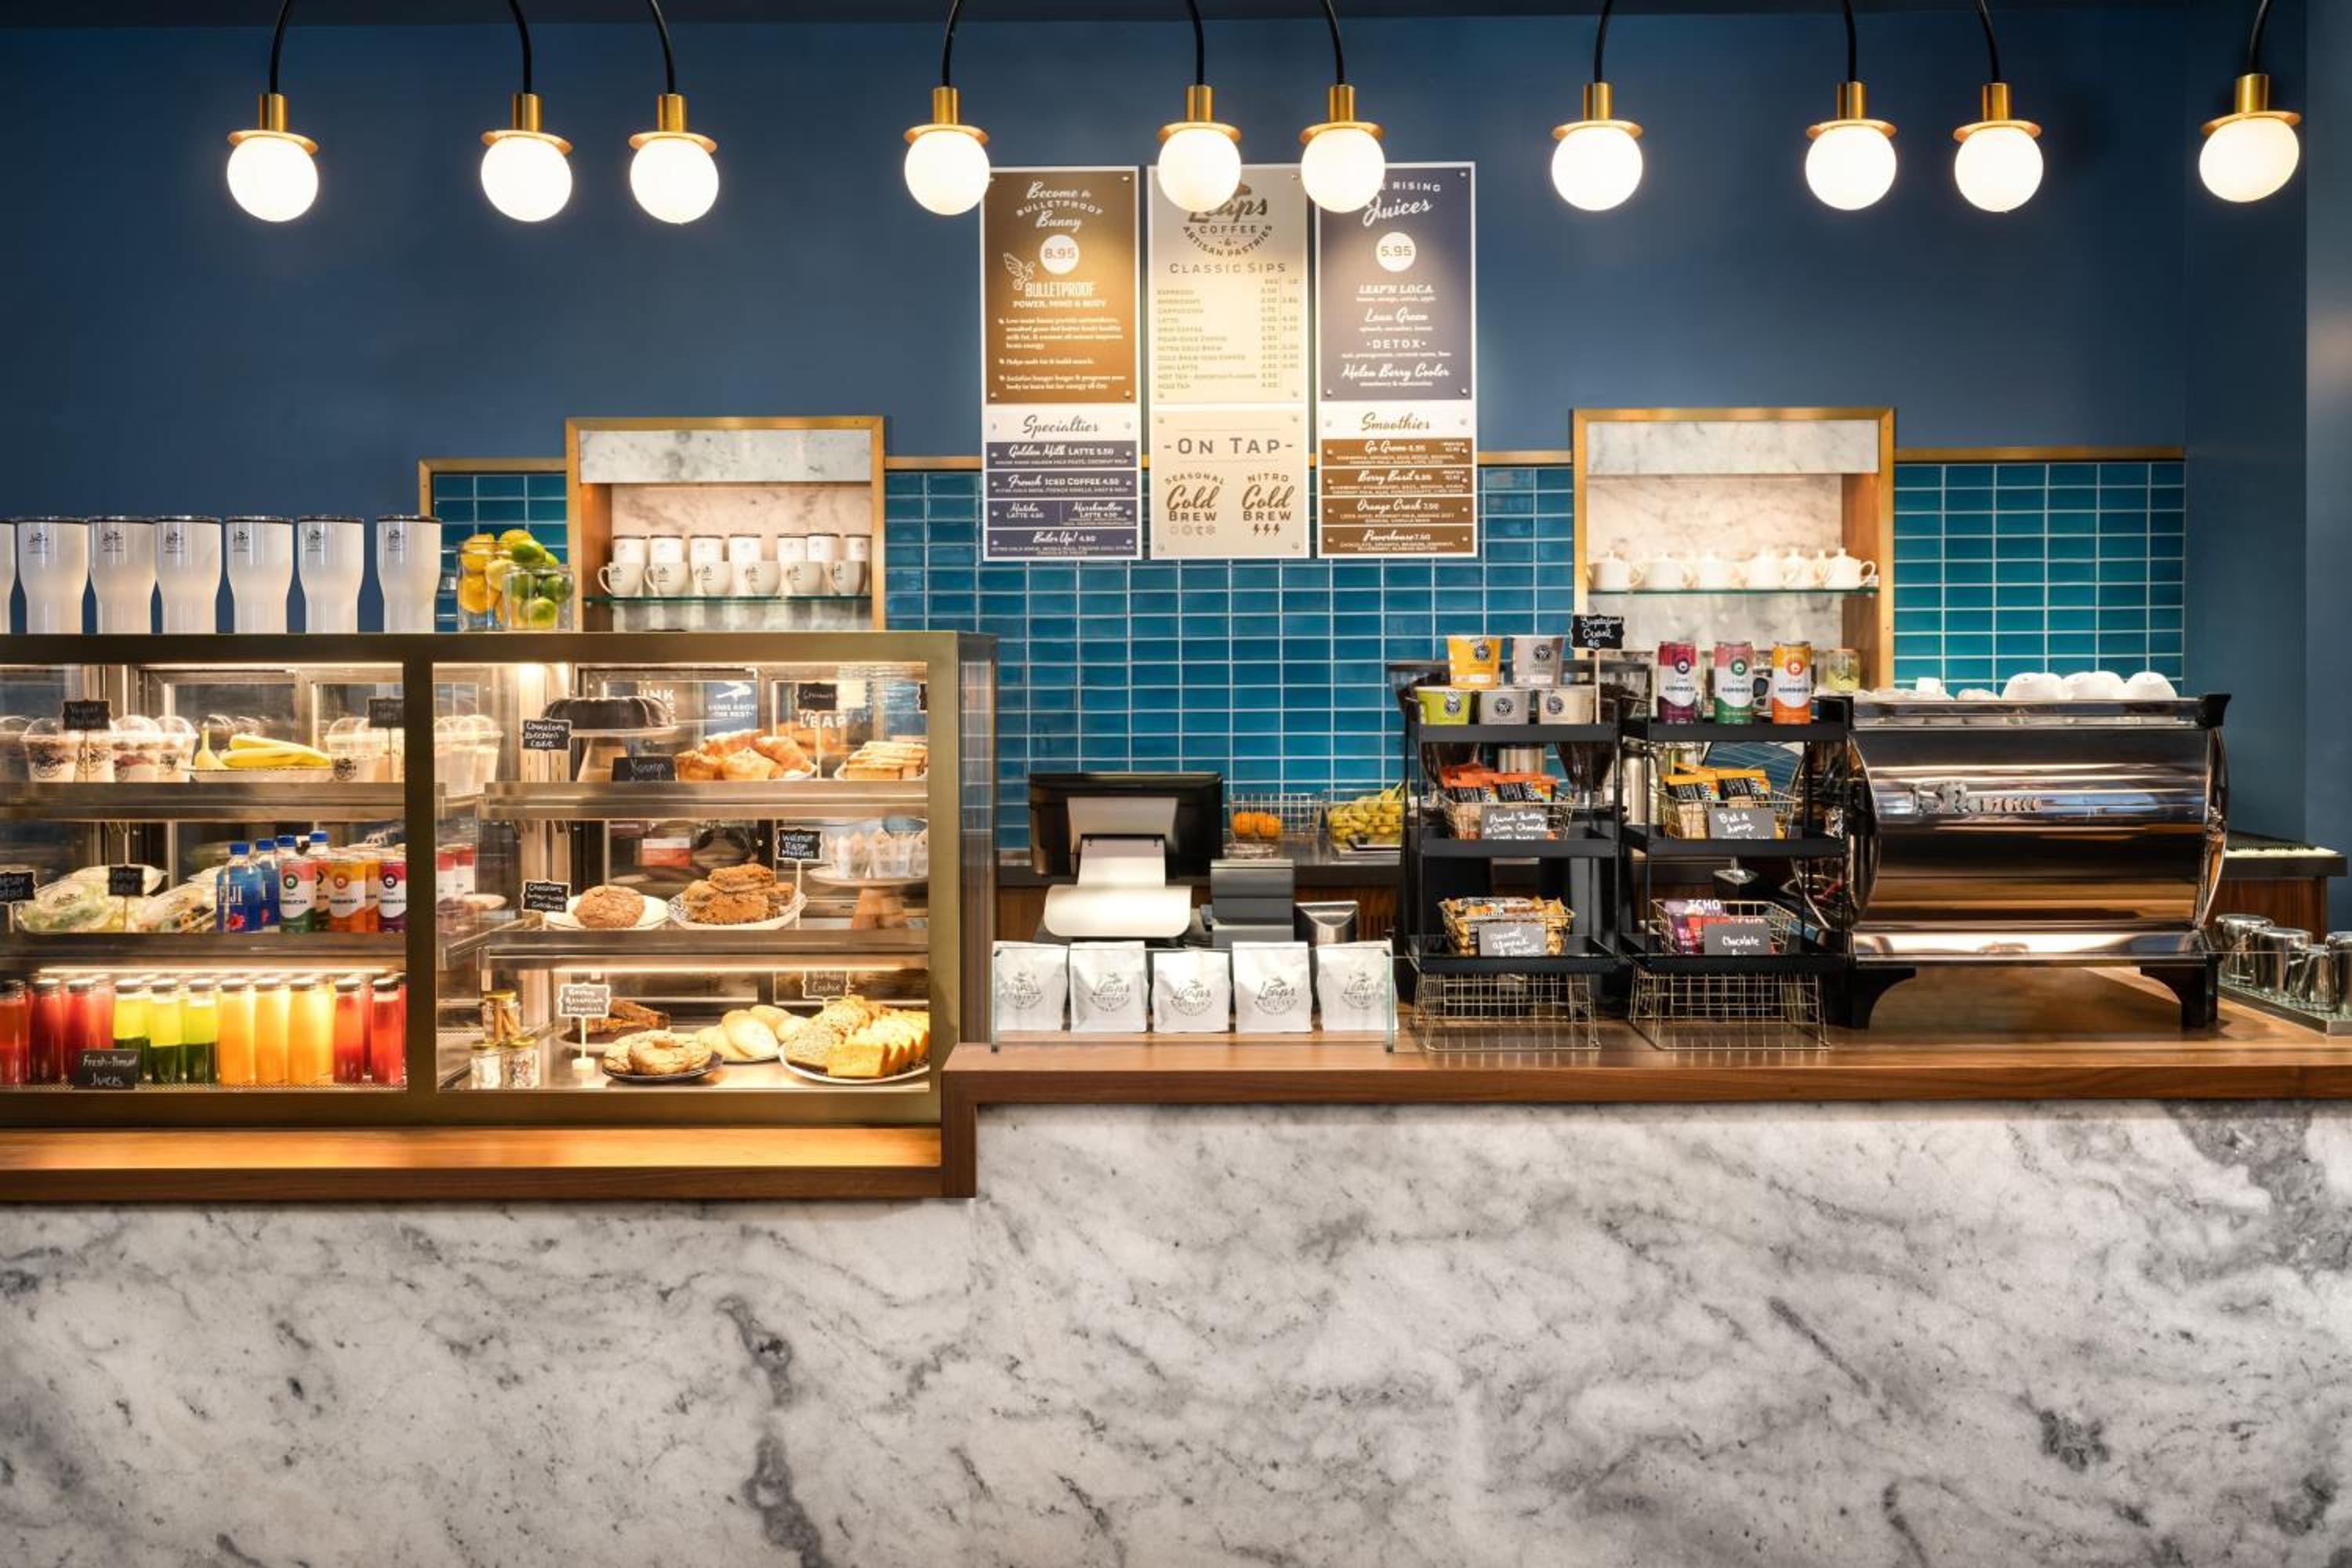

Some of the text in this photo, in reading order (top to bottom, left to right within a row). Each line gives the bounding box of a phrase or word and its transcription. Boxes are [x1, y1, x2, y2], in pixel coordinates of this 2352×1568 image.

[1027, 181, 1078, 199] Become
[1392, 181, 1441, 192] RISING
[1016, 200, 1104, 216] BULLETPROOF
[1363, 196, 1433, 227] Juices
[1036, 210, 1082, 233] Bunny
[1199, 225, 1258, 234] COFFEE
[1183, 225, 1272, 256] ARTISAN PASTRIES
[1044, 249, 1076, 260] 8.95
[1381, 245, 1412, 256] 5.95
[1169, 263, 1287, 274] CLASSIC SIPS
[1025, 281, 1094, 297] BULLETPROOF
[1399, 285, 1434, 294] LOCA
[1396, 306, 1428, 323] Green
[1373, 339, 1421, 349] DETOX
[1378, 363, 1412, 382] Berry
[1414, 362, 1450, 378] Cooler
[1022, 415, 1098, 438] Specialties
[1361, 412, 1431, 432] Smoothies
[1365, 440, 1406, 453] Go Green
[1008, 474, 1042, 488] French
[1164, 472, 1225, 485] SEASONAL
[1247, 472, 1289, 483] NITRO
[1357, 470, 1386, 485] Berry
[1166, 484, 1221, 510] Cold
[1241, 484, 1295, 510] Cold
[1357, 498, 1391, 514] Orange
[1169, 510, 1218, 521] BREW
[1243, 510, 1292, 521] BREW
[1363, 529, 1414, 542] Powerhouse
